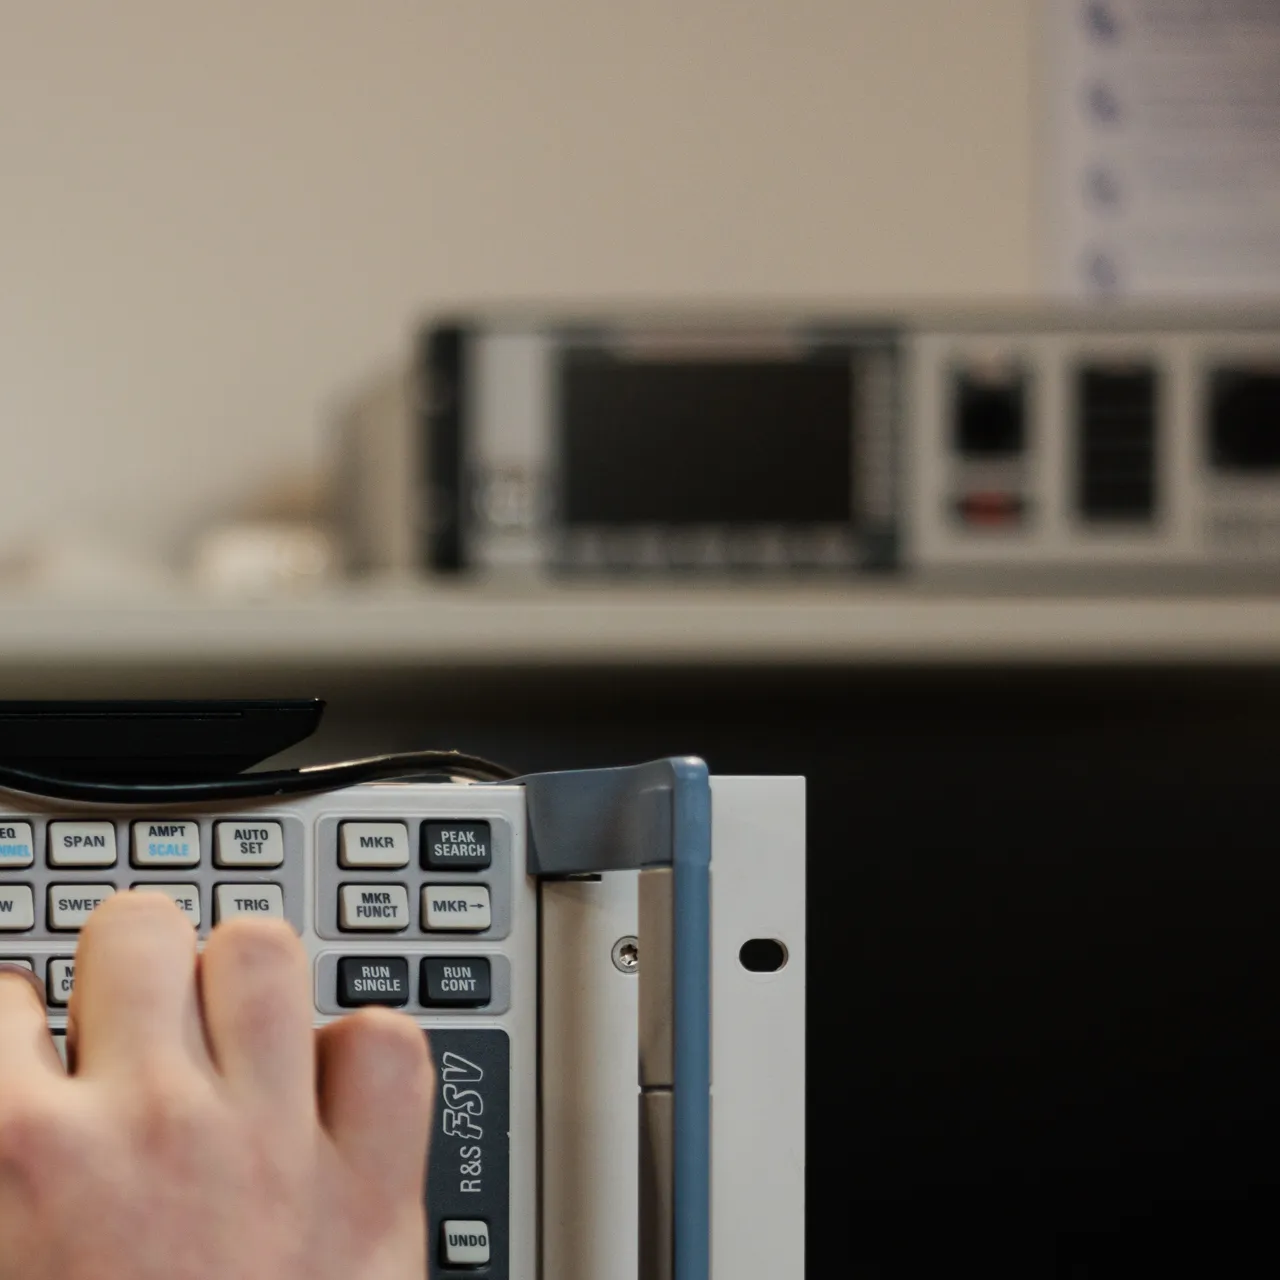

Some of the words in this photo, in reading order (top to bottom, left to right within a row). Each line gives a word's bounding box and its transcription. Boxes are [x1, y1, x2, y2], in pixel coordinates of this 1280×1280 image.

[148, 826, 186, 838] AMPT
[234, 828, 269, 842] AUTO
[440, 831, 476, 844] PEAK
[63, 835, 105, 848] SPAN
[240, 842, 263, 854] SET
[360, 836, 394, 848] MKR
[148, 843, 190, 856] SCALE
[434, 844, 486, 857] SEARCH
[58, 899, 104, 910] SWEE
[234, 898, 270, 911] TRIG
[362, 892, 392, 905] MKR
[356, 904, 398, 918] FUNCT
[433, 900, 468, 912] MKR
[362, 966, 390, 979] RUN
[443, 966, 471, 979] RUN
[354, 978, 400, 992] SINGLE
[441, 979, 476, 992] CONT
[443, 1052, 484, 1140] FSV
[460, 1146, 481, 1192] R&S
[449, 1234, 486, 1246] UNDO
